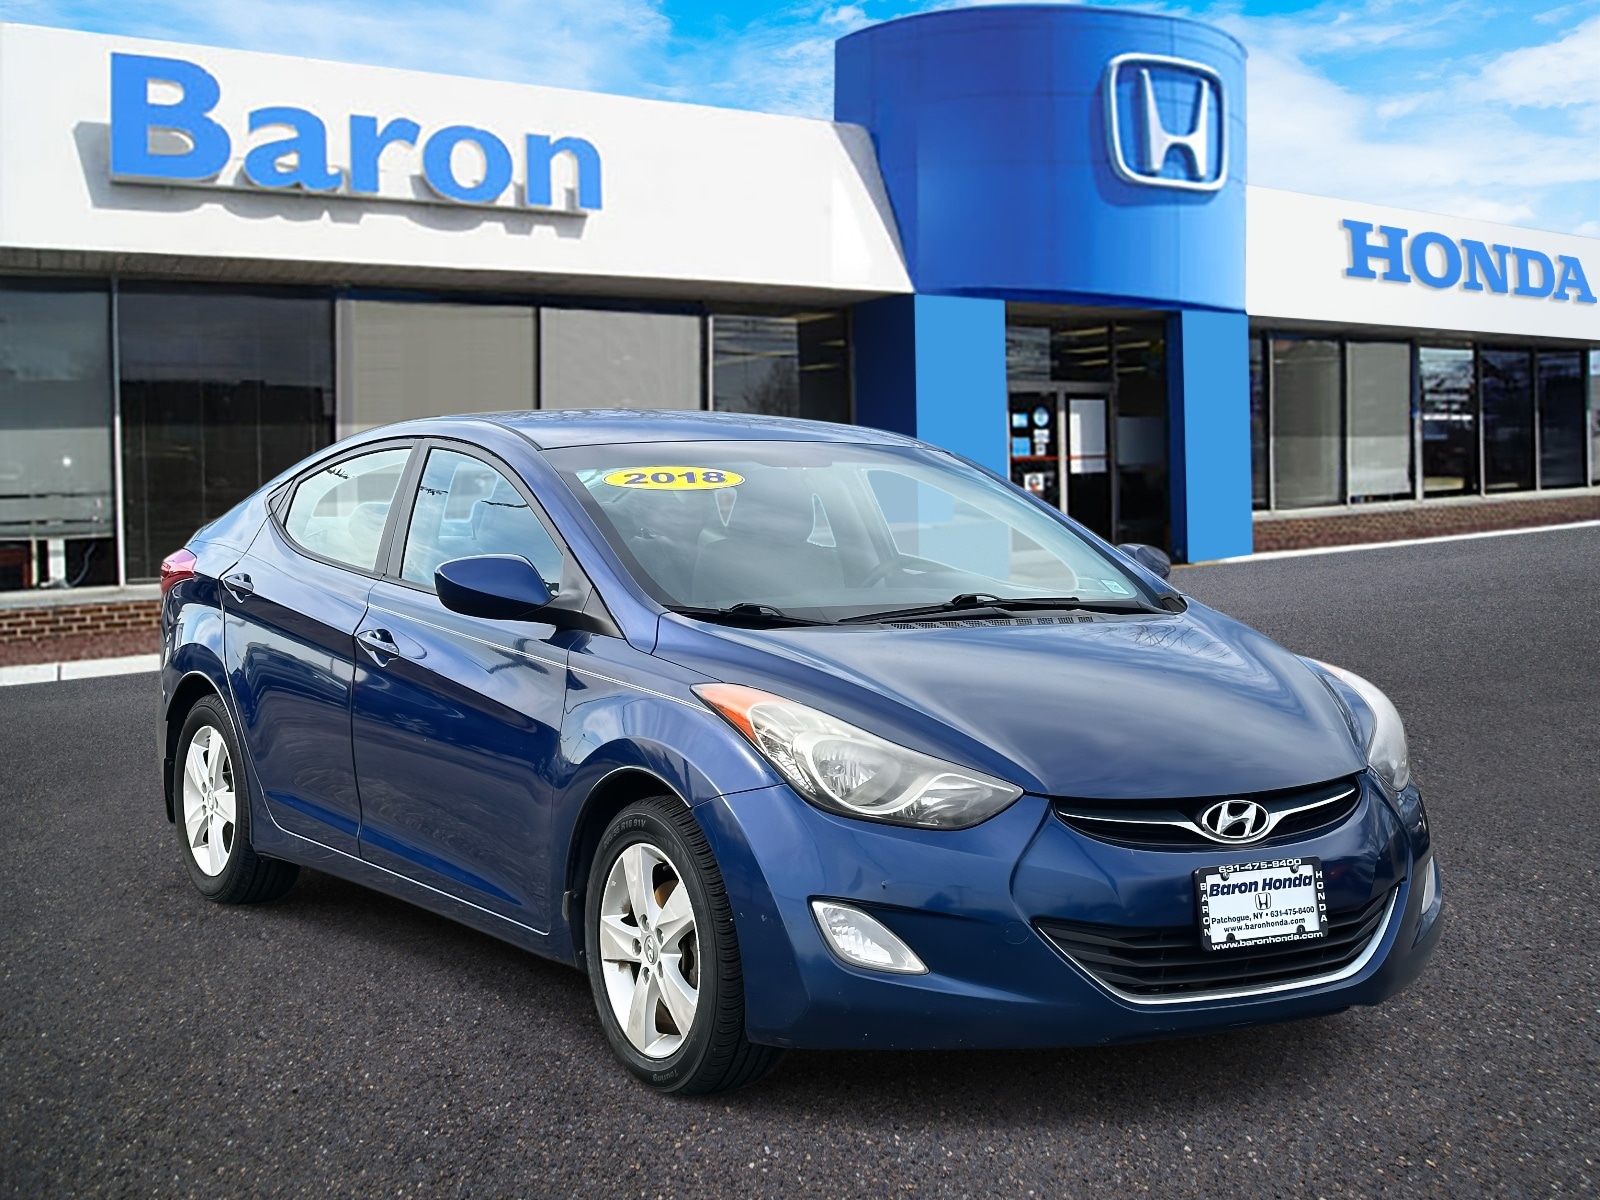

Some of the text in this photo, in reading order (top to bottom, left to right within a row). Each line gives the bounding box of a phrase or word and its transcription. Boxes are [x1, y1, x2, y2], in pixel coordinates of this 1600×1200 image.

[110, 51, 603, 211] Baron
[1342, 219, 1598, 304] HONDA
[623, 471, 727, 485] 2018
[1218, 858, 1302, 873] 631-475-8400
[1209, 873, 1313, 898] Baron Honda
[1211, 905, 1315, 925] Patchogue, NY 631-475-8400
[1223, 917, 1306, 933] www.baronhonda.com
[1211, 931, 1323, 951] www.baronhonda.com
